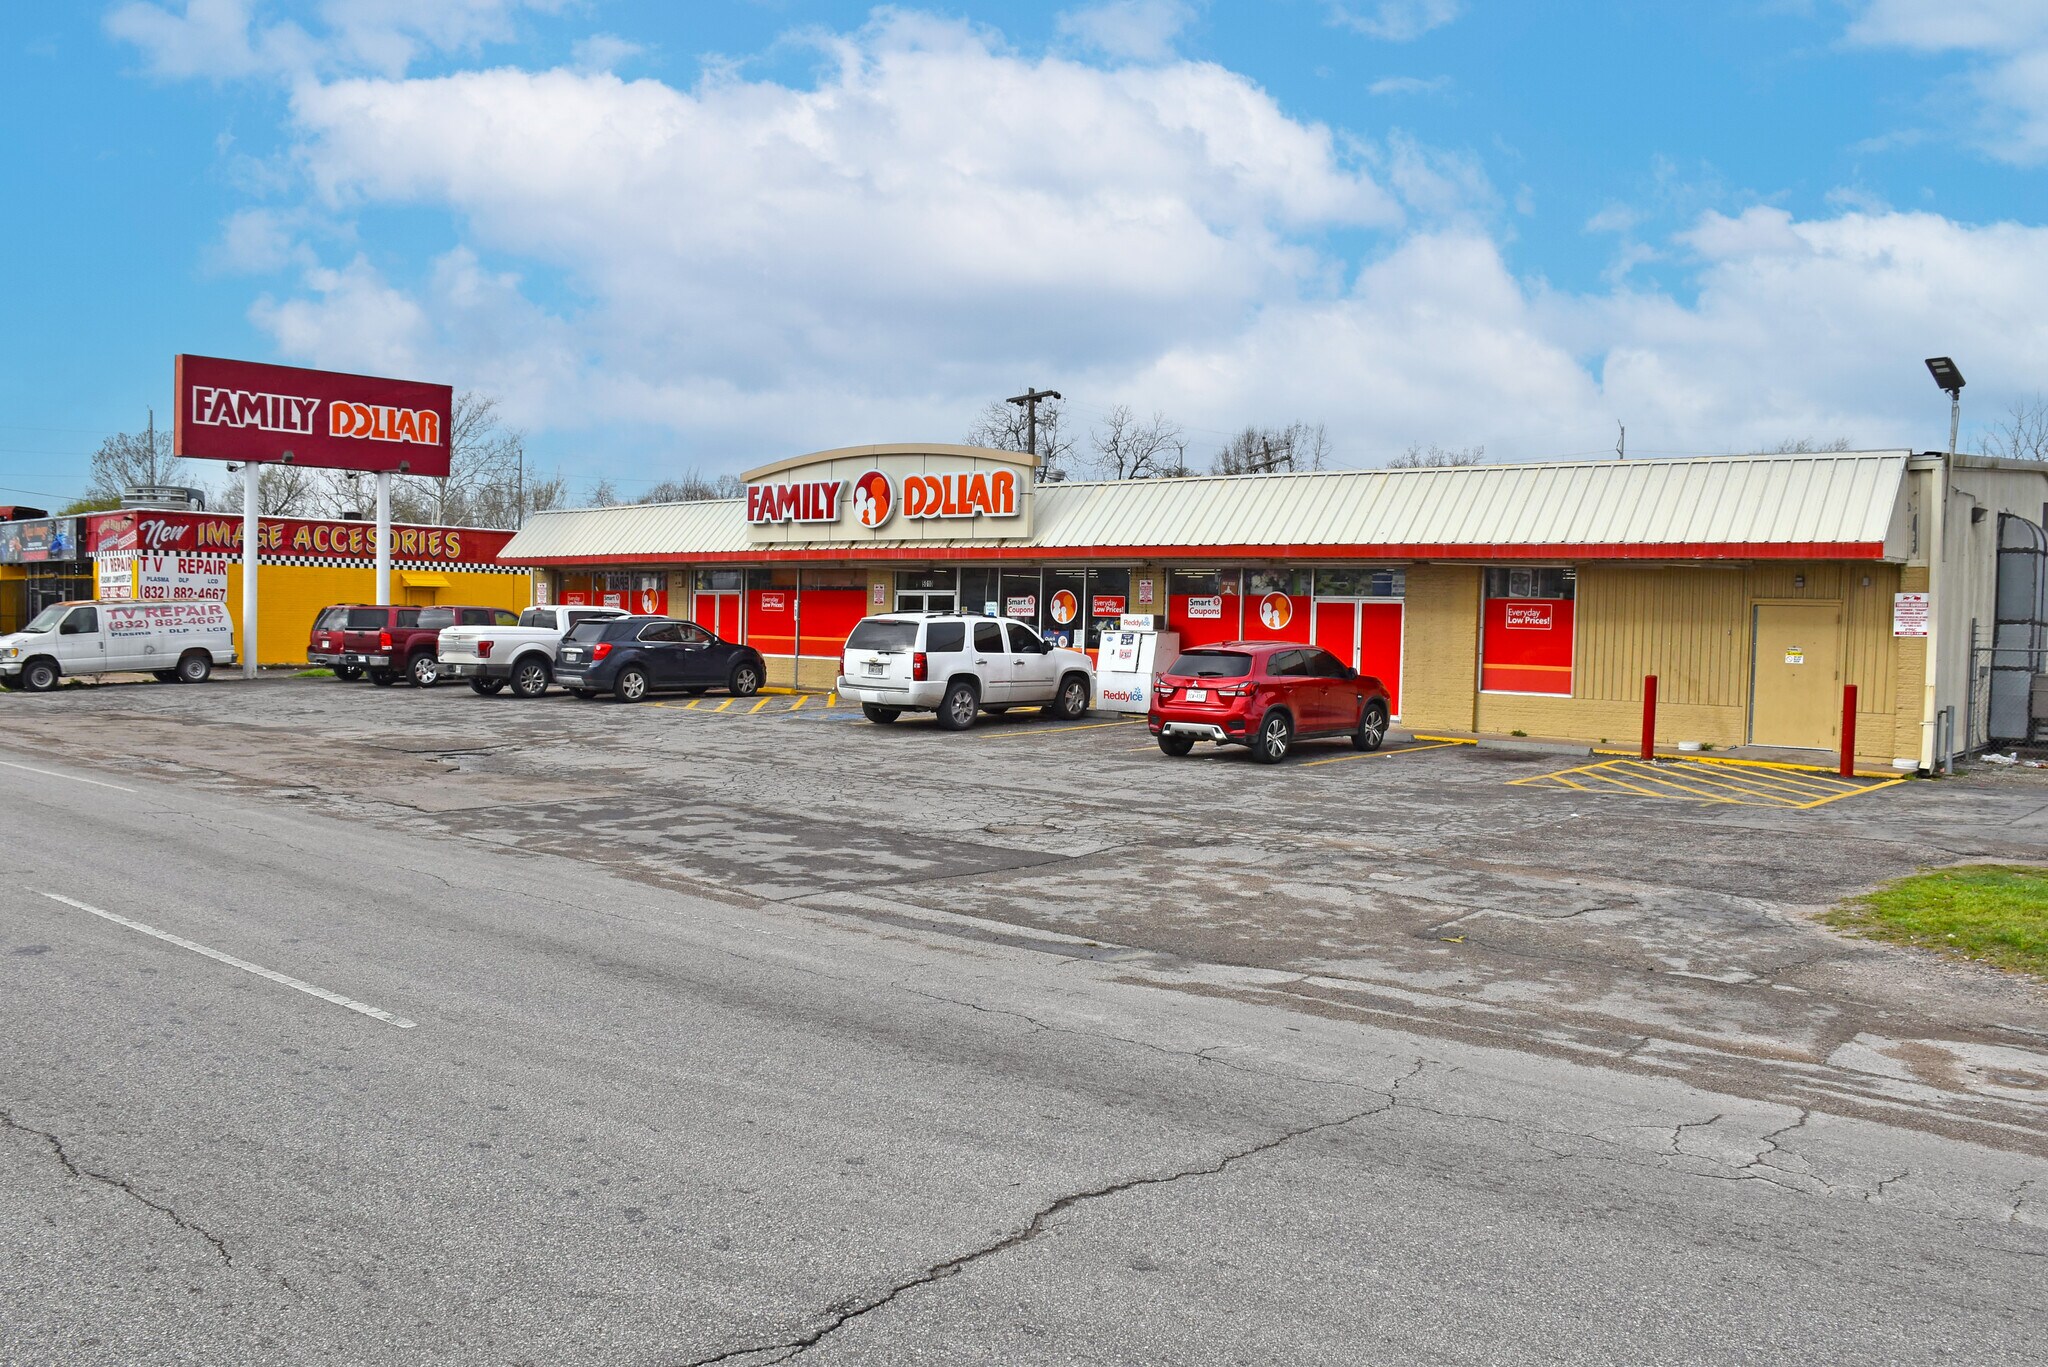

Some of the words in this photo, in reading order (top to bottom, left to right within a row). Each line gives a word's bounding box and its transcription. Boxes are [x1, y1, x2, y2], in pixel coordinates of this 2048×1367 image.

[192, 385, 321, 434] FAMILY
[329, 400, 440, 446] DOLLAR
[747, 481, 843, 523] FAMILY
[902, 468, 1015, 518] DOLLAR
[139, 519, 189, 549] New
[101, 558, 109, 573] TV
[110, 557, 132, 572] REPAIR
[178, 558, 227, 575] REPAIR
[1094, 598, 1117, 607] Everyday
[1189, 598, 1211, 606] Smart
[106, 609, 137, 620] TV
[144, 605, 223, 618] REPAIR
[1008, 606, 1034, 614] Coupons
[1189, 607, 1220, 616] Coupons
[1508, 608, 1541, 618] Everyday
[108, 619, 149, 630] (832)
[154, 616, 224, 627] 882-4667
[1508, 616, 1523, 624] Low
[1525, 616, 1550, 625] Prices!
